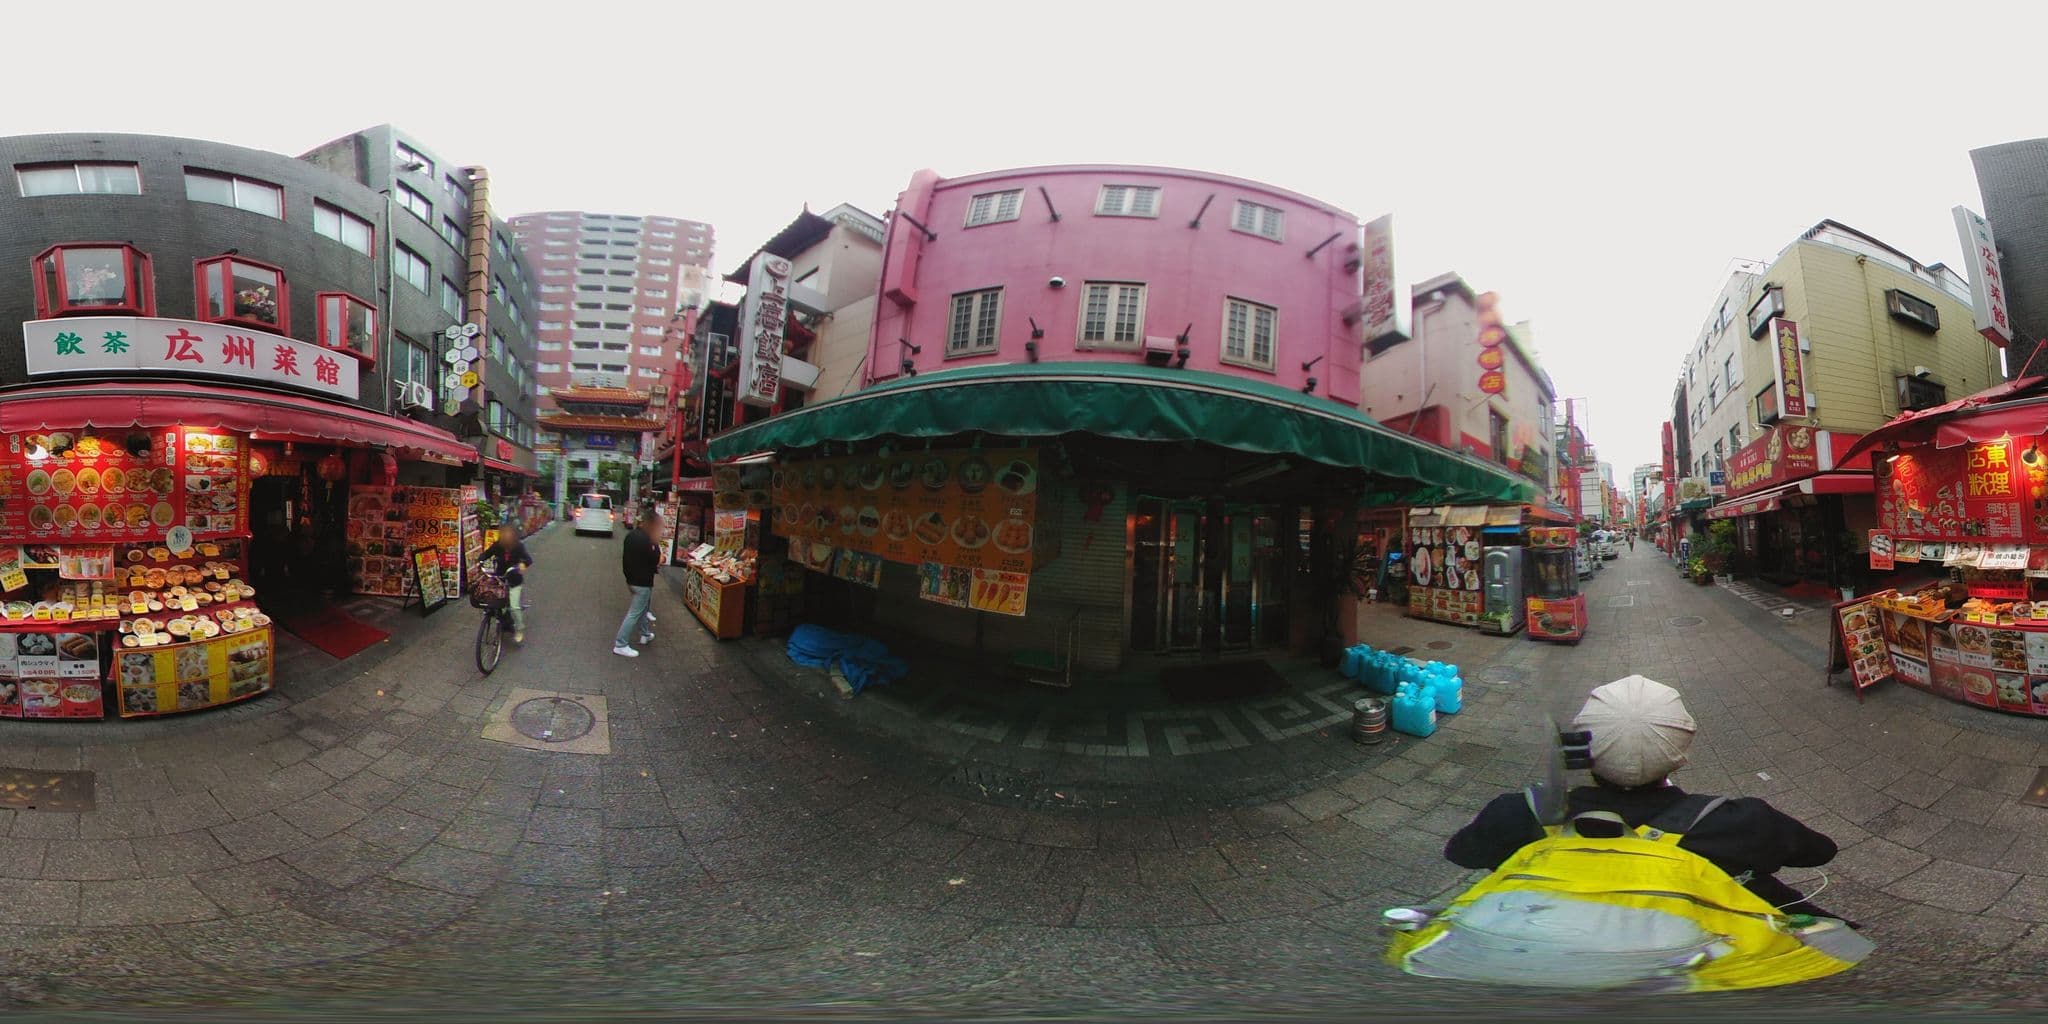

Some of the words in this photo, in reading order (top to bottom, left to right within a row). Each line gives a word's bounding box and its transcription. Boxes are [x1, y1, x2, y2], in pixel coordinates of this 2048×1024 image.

[1982, 245, 2006, 328] 広州菜館
[53, 331, 131, 355] 飲茶
[163, 328, 341, 386] 広州菜館
